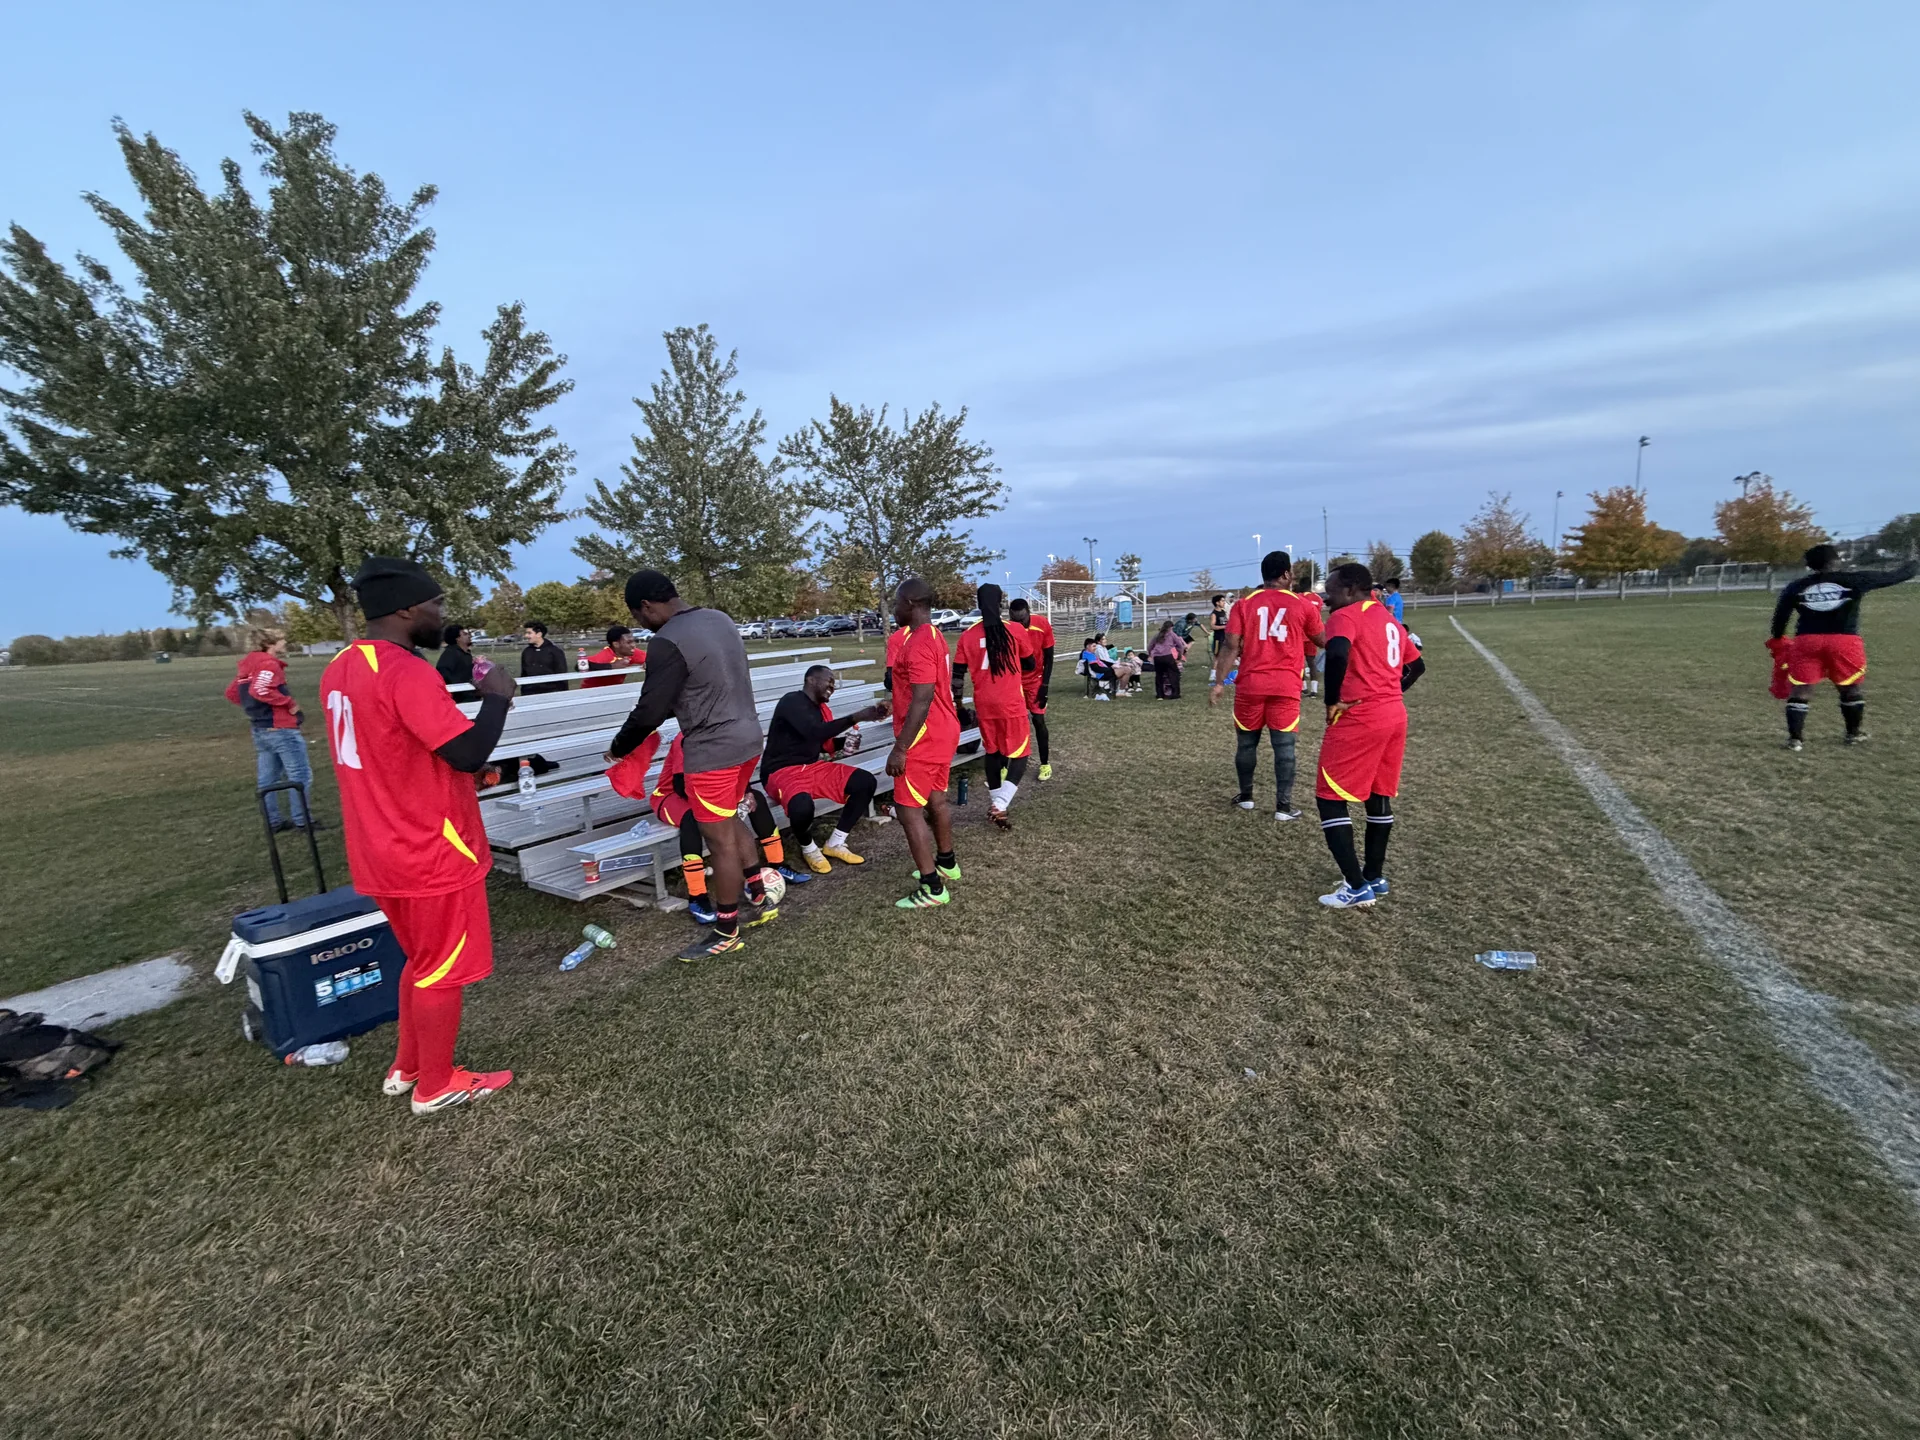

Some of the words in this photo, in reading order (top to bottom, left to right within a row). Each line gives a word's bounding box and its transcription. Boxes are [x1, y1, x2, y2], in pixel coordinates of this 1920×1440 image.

[1257, 606, 1288, 643] 14
[1385, 622, 1401, 668] 8
[310, 937, 374, 965] IGLOO
[315, 980, 334, 997] 5
